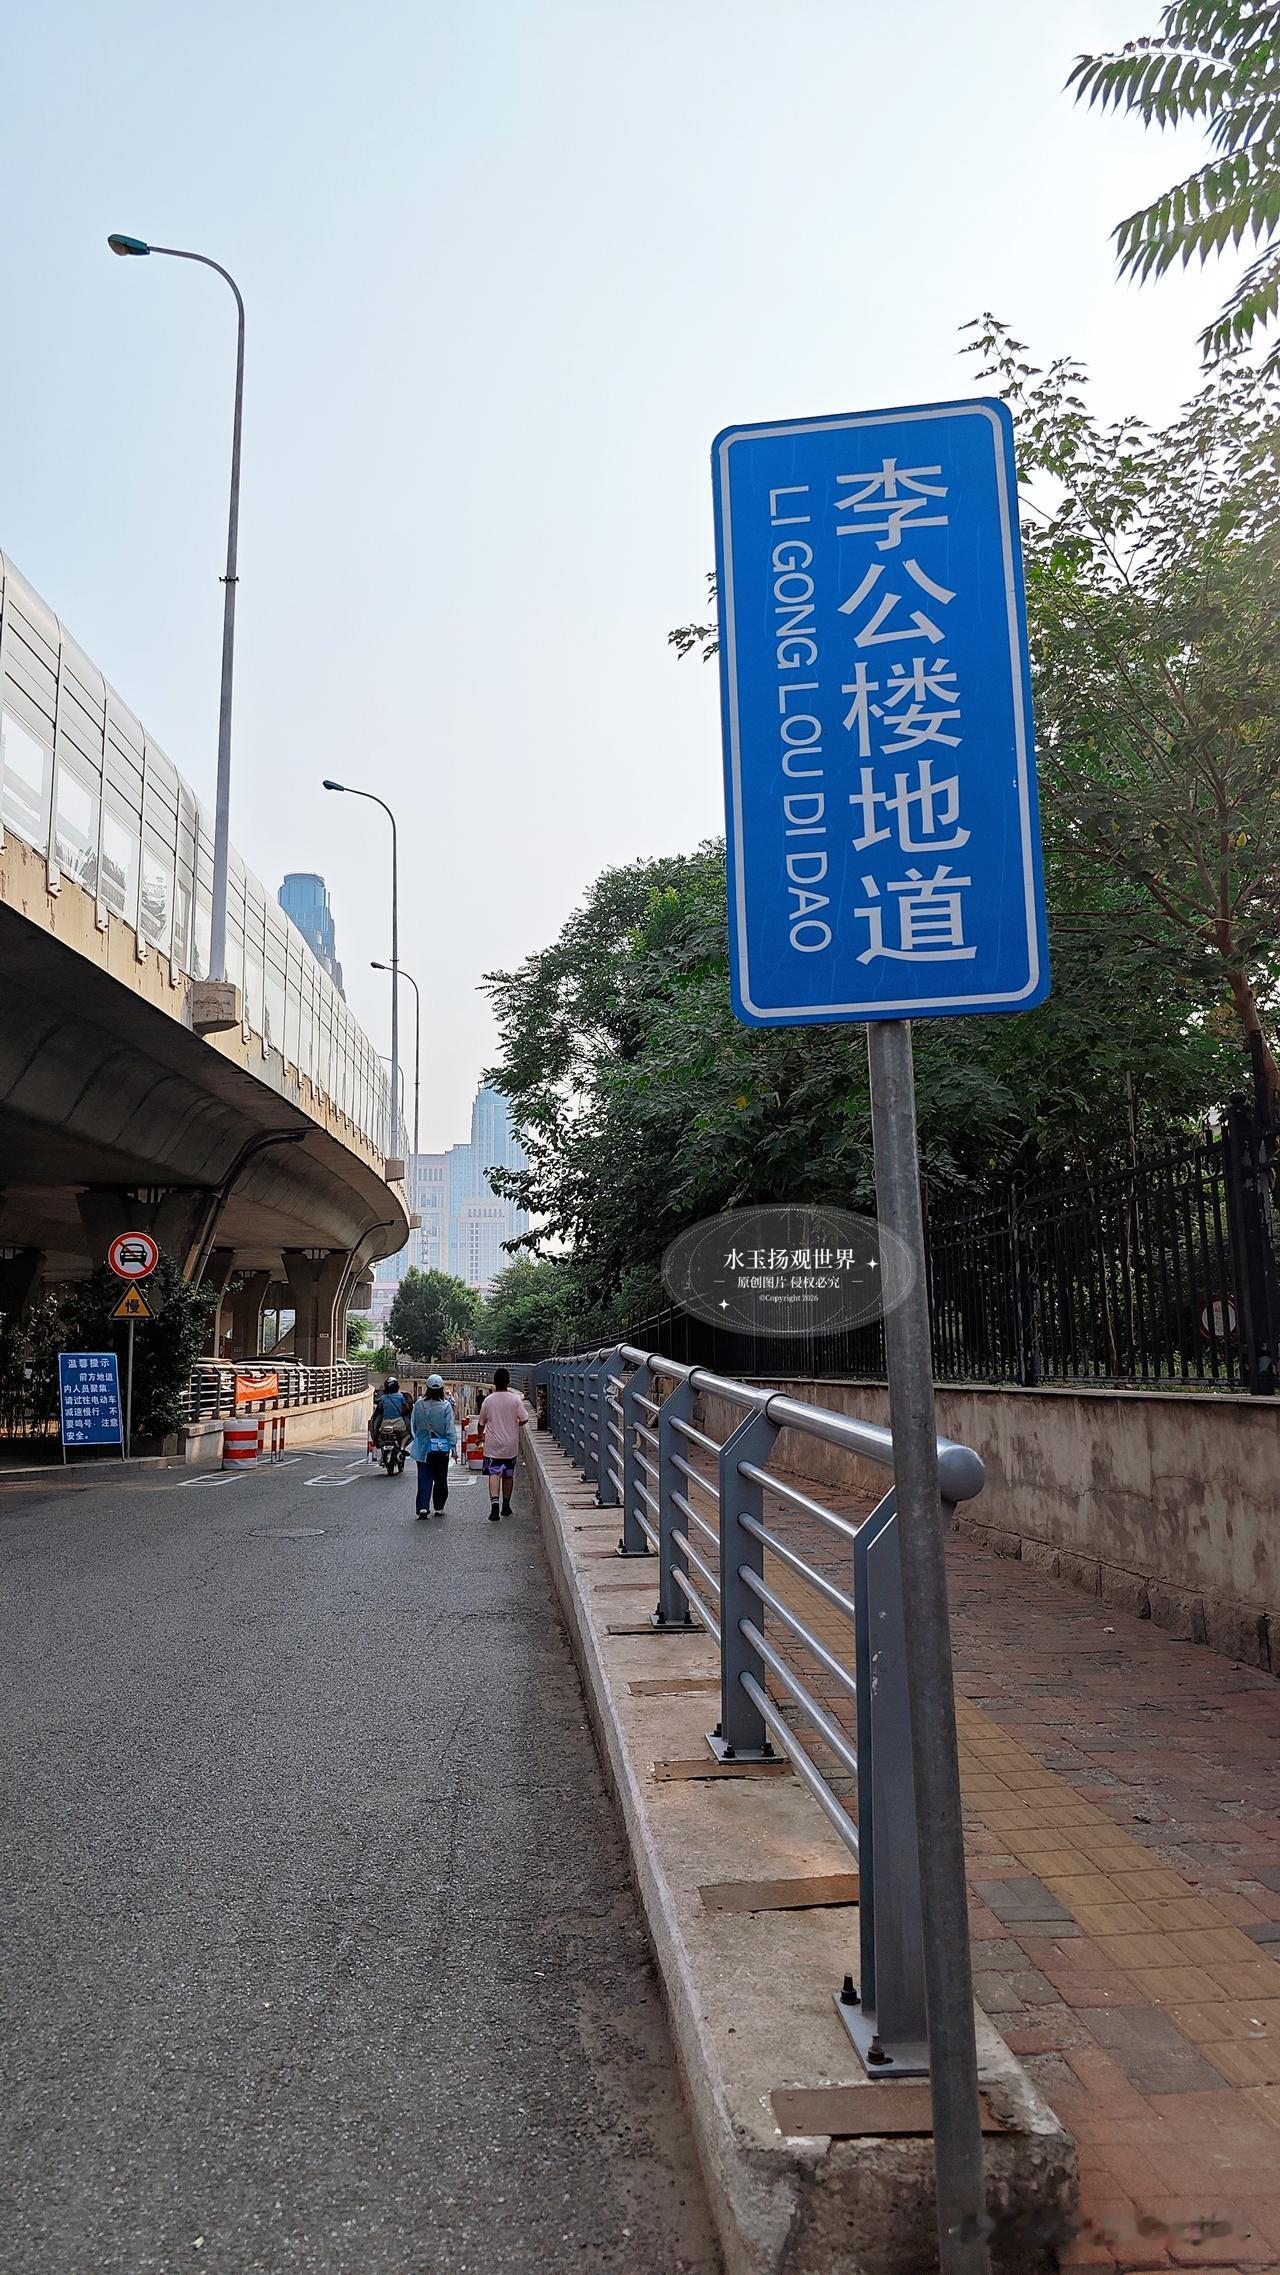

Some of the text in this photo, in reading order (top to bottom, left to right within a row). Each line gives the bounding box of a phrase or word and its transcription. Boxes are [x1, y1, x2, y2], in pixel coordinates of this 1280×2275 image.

[834, 458, 978, 966] 李公楼地道
[769, 485, 833, 954] LI GONG LOU DI DAO
[67, 1358, 110, 1368] 温馨提示
[79, 1372, 113, 1382] 前方地道
[65, 1396, 117, 1405] 请过往电动车
